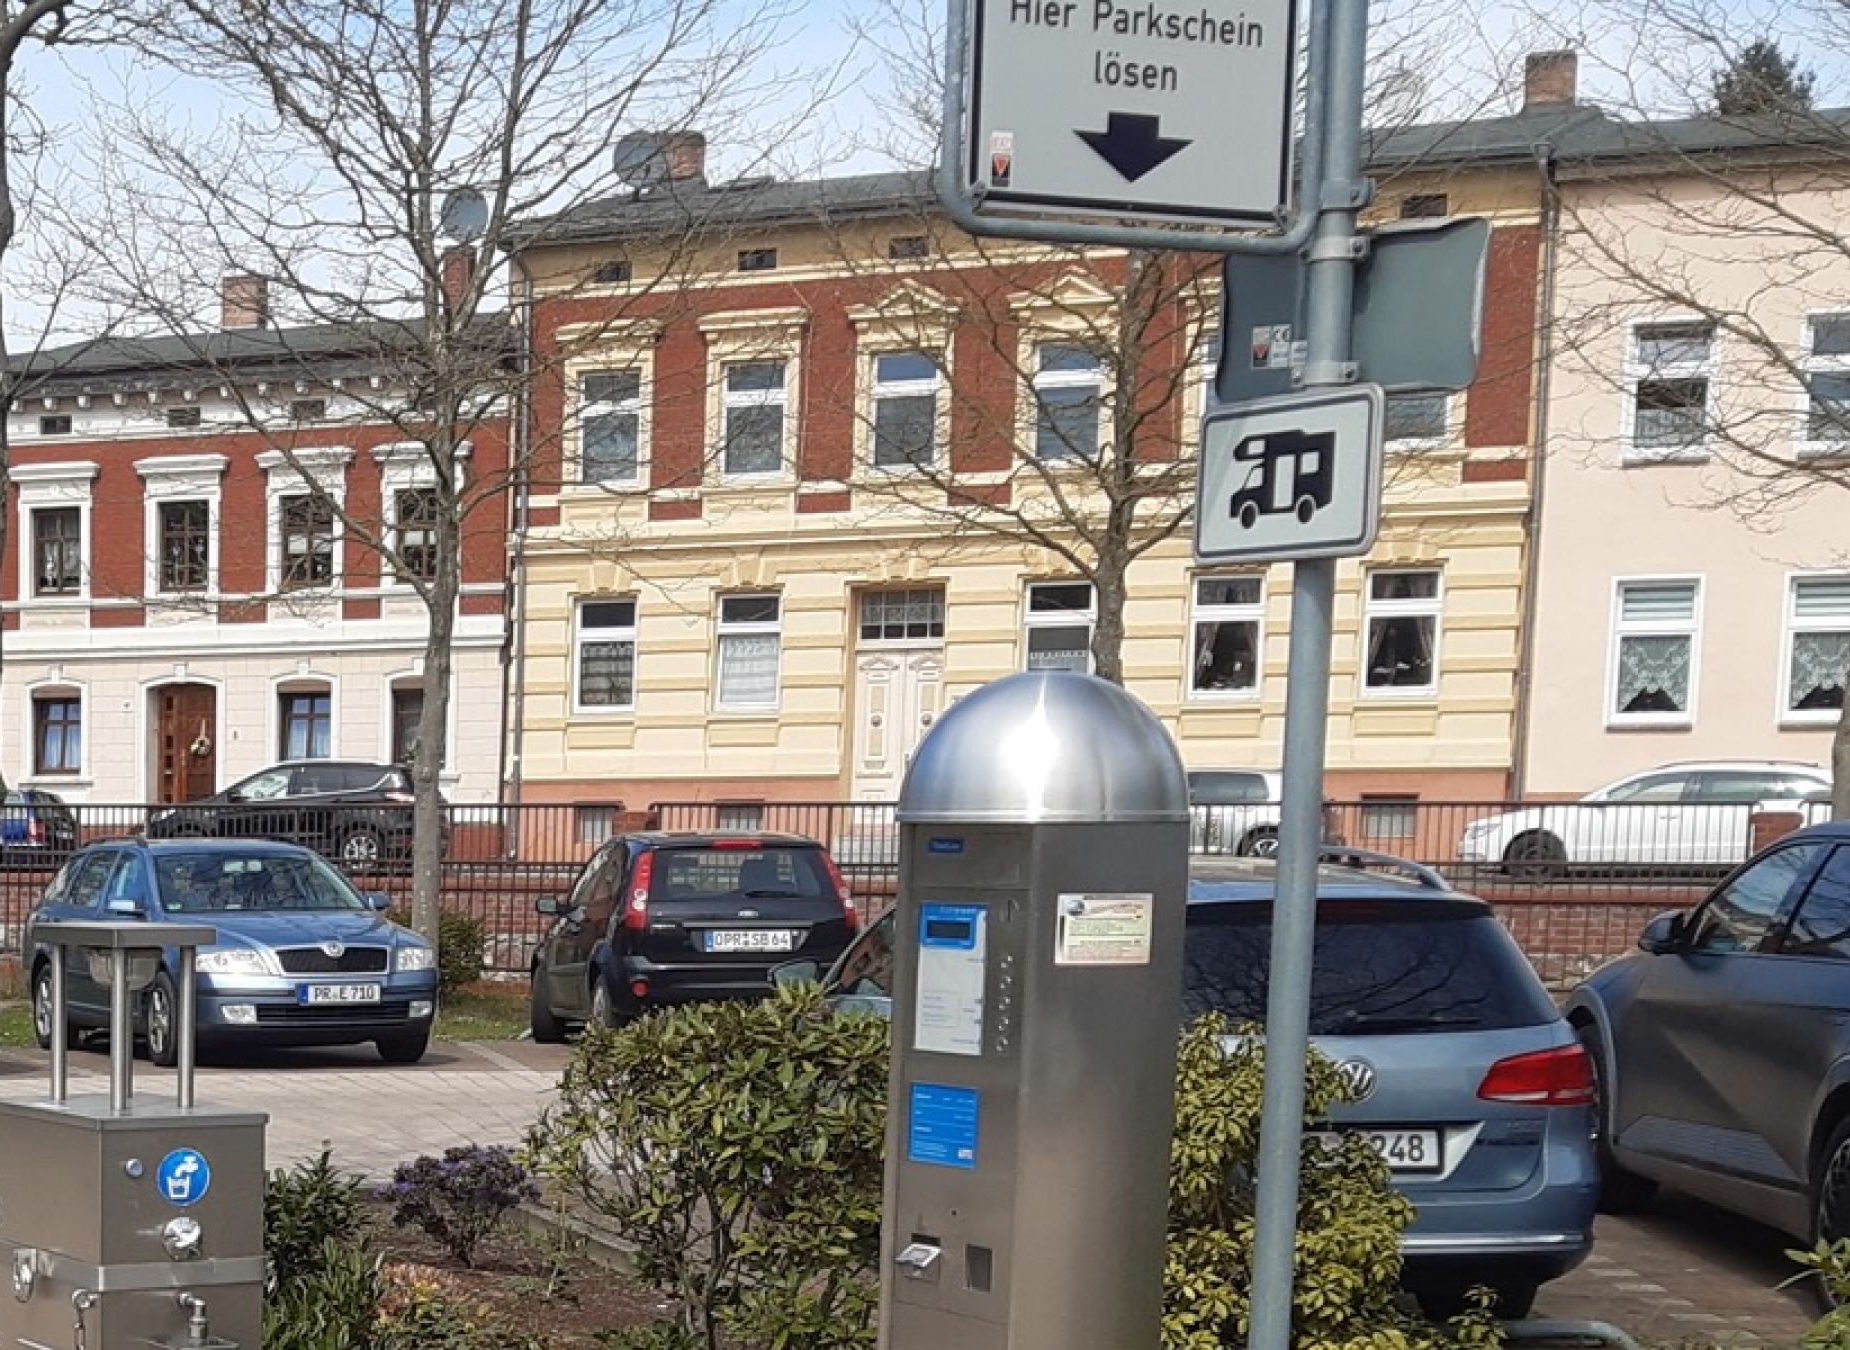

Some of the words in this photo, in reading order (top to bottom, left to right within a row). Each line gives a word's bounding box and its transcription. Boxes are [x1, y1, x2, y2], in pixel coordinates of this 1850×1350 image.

[1010, 0, 1077, 28] Hier
[1092, 0, 1264, 48] Parkschein
[1094, 50, 1178, 91] lösen
